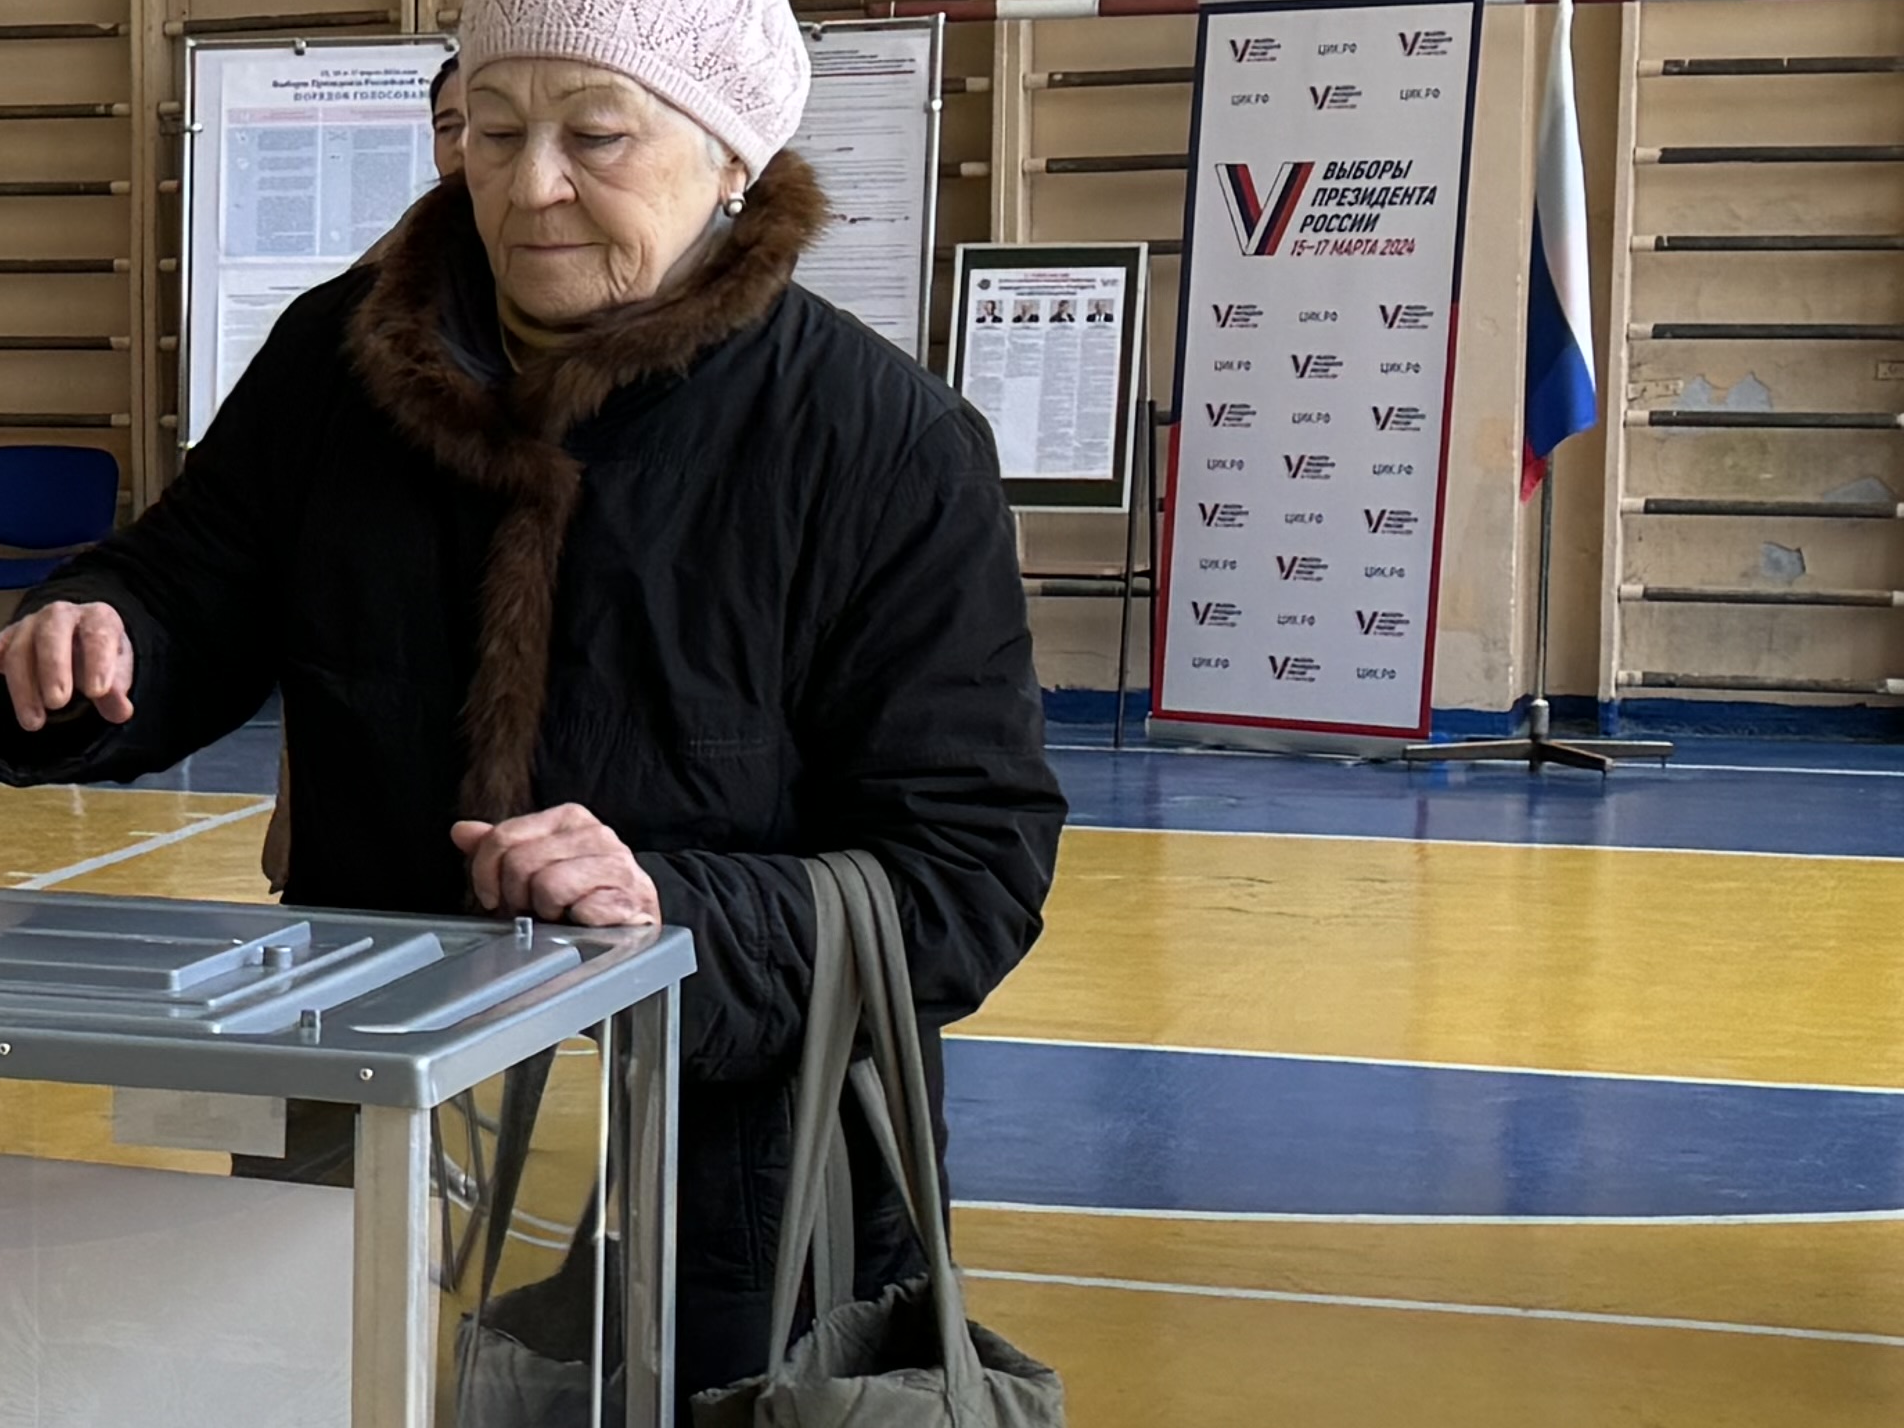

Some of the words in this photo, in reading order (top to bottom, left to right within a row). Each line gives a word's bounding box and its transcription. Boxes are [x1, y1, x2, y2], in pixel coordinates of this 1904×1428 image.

[1323, 160, 1413, 180] ВЫБОРЫ
[1311, 186, 1437, 208] ПРЕЗИДЕНТА
[1300, 214, 1380, 233] РОССИИ
[1330, 239, 1378, 255] МАРТА
[1379, 239, 1414, 255] 2024
